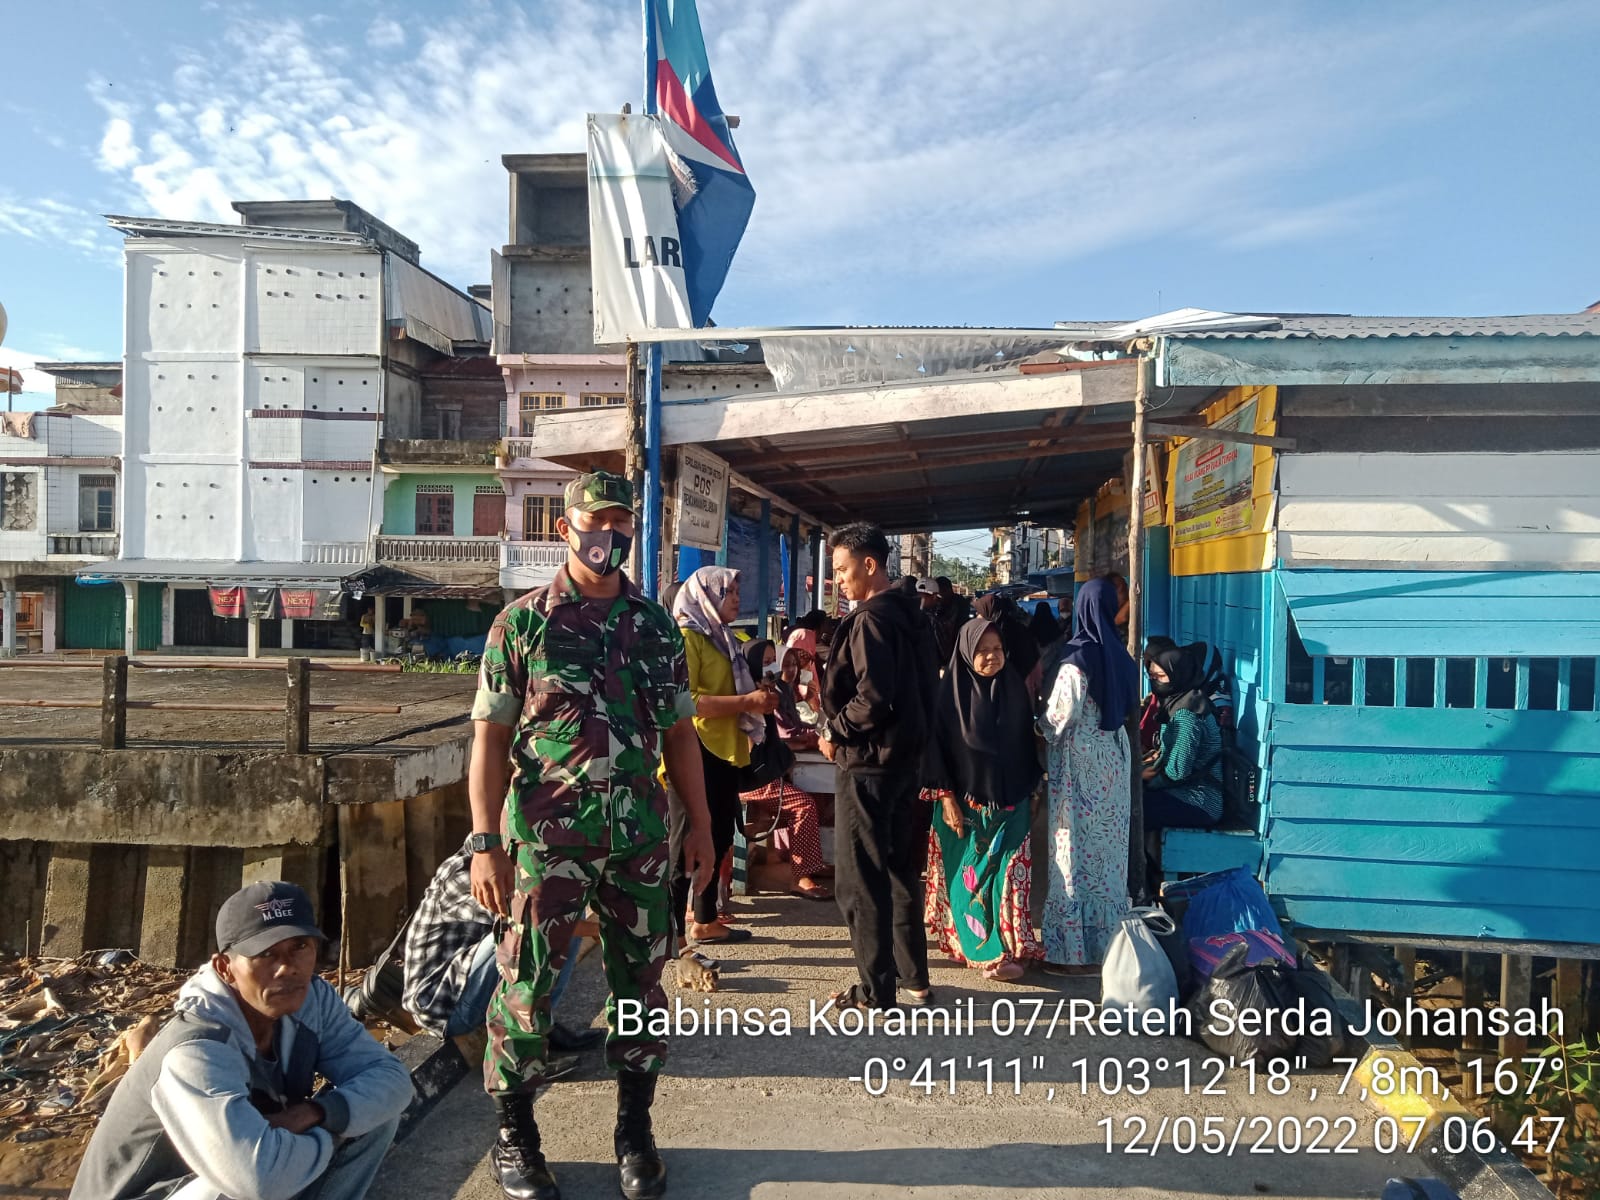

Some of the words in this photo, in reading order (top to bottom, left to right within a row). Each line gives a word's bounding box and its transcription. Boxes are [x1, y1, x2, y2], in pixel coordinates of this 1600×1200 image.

[623, 236, 682, 269] LAR
[694, 474, 711, 496] POS
[218, 595, 240, 603] NEXT
